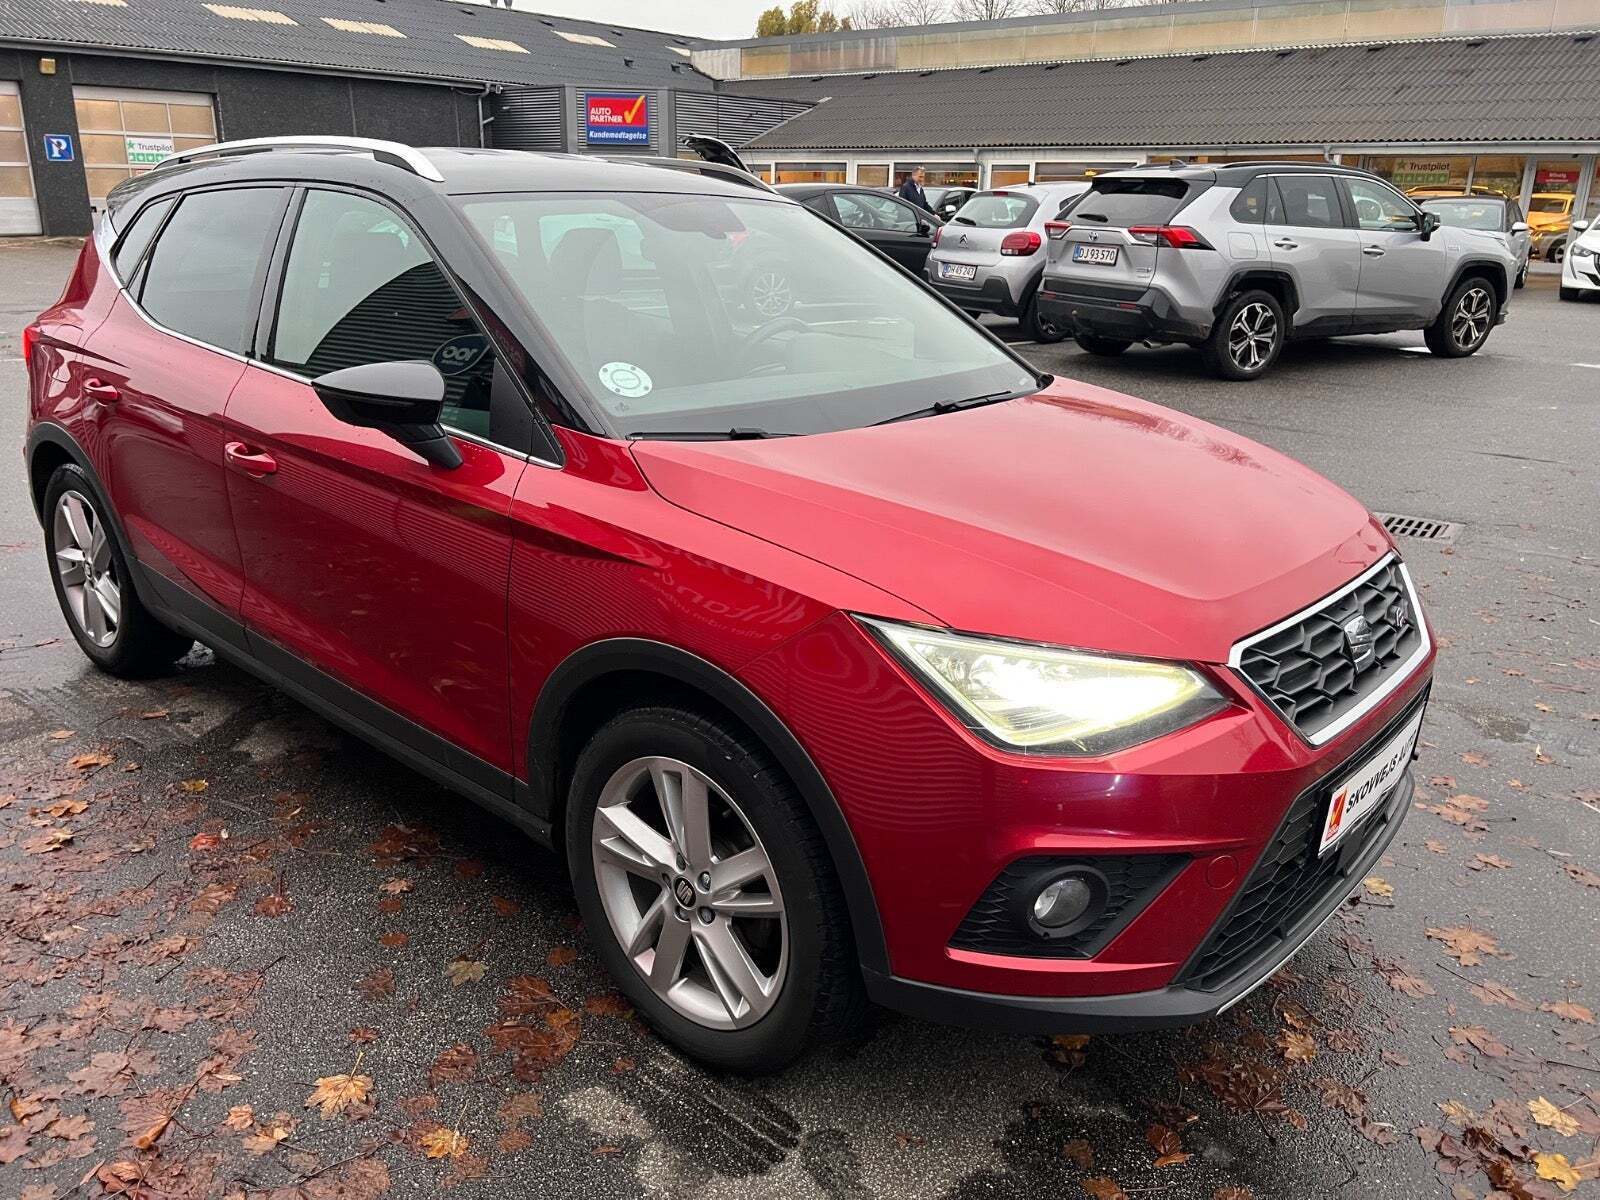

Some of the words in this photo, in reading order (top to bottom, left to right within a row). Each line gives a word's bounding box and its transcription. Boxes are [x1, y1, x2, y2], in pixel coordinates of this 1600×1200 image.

[590, 107, 612, 116] AUTO
[590, 115, 623, 123] PARTNER
[49, 138, 67, 157] P
[137, 143, 174, 152] Trustpilot
[1410, 161, 1450, 171] Trustpilot
